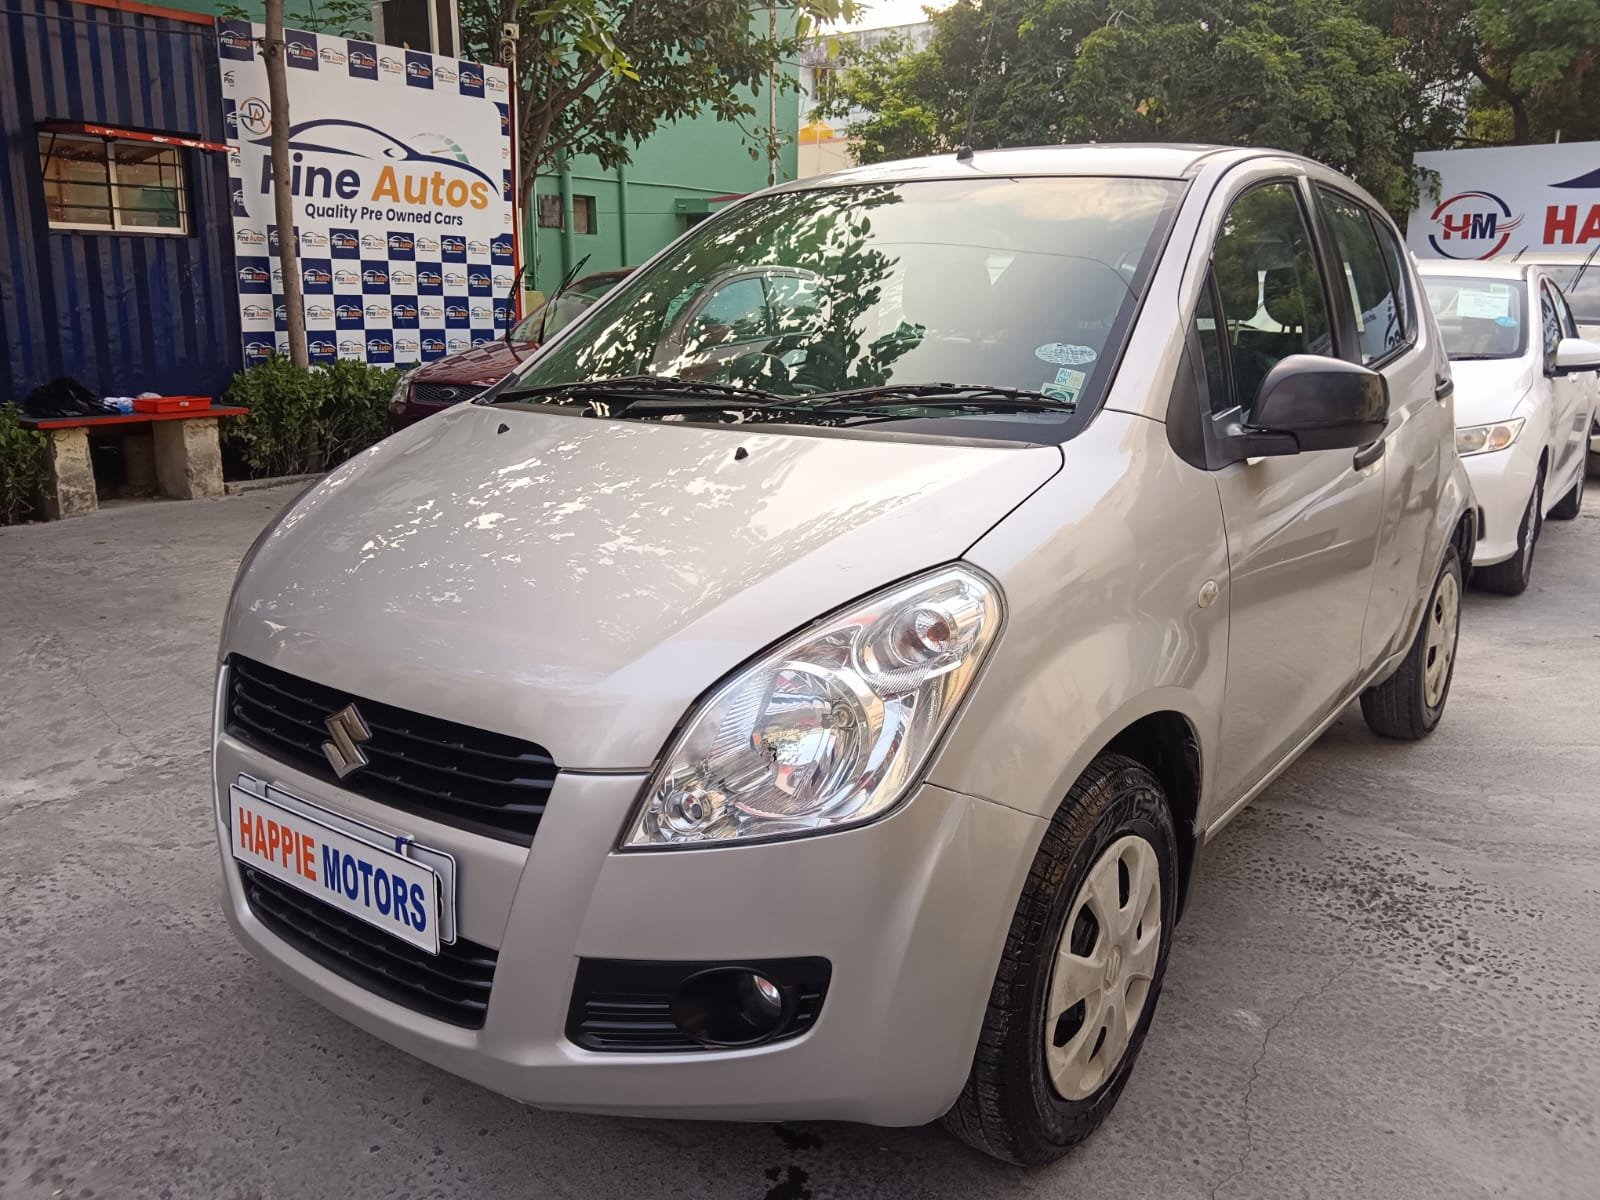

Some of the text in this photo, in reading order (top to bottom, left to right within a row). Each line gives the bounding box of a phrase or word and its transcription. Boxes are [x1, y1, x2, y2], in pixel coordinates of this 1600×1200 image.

[371, 165, 488, 209] Autos
[305, 203, 463, 226] Quality Pre Owned Cars
[1443, 213, 1497, 240] HM
[239, 806, 427, 932] HAPPIE MOTORS
